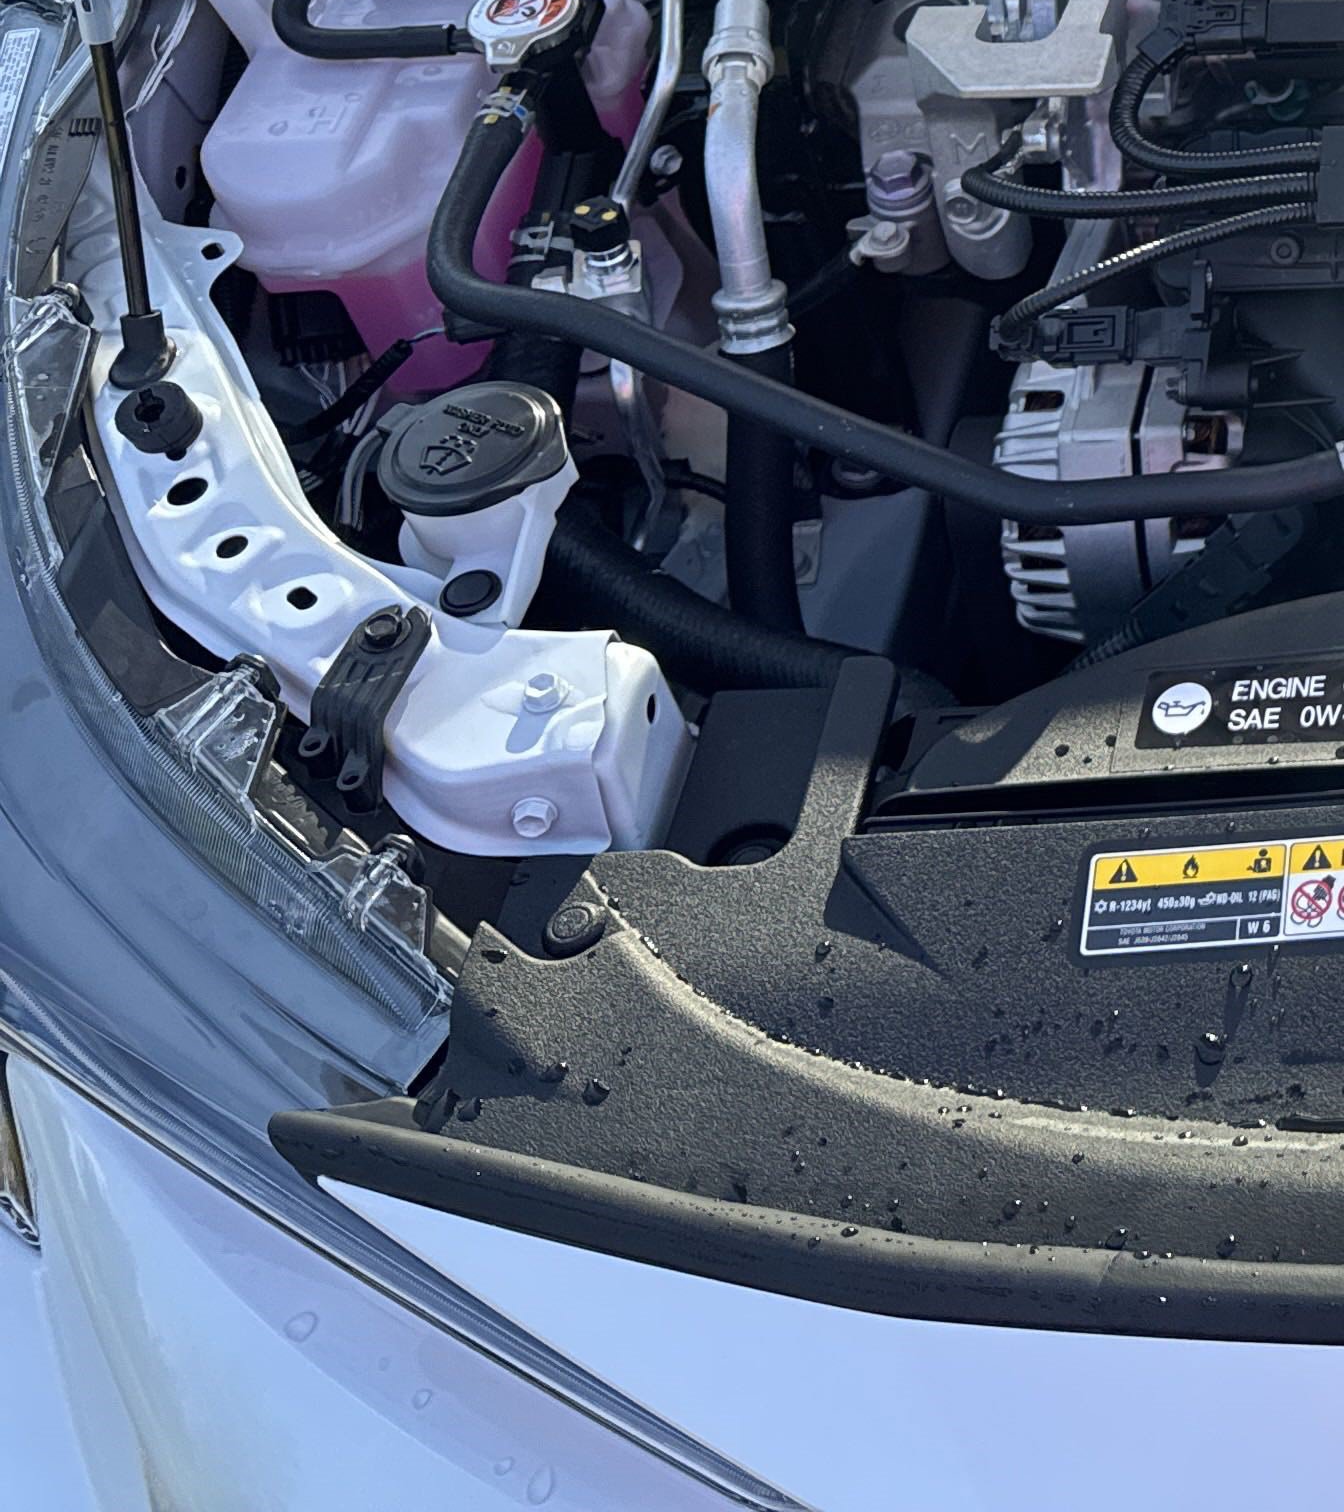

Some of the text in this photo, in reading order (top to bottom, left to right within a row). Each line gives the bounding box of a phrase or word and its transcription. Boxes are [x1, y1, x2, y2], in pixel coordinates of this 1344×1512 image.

[1231, 675, 1326, 702] ENGINE
[1227, 706, 1282, 732] SAE
[1248, 890, 1258, 903] 12
[1259, 888, 1281, 904] (PAG)
[1247, 920, 1271, 935] W 6
